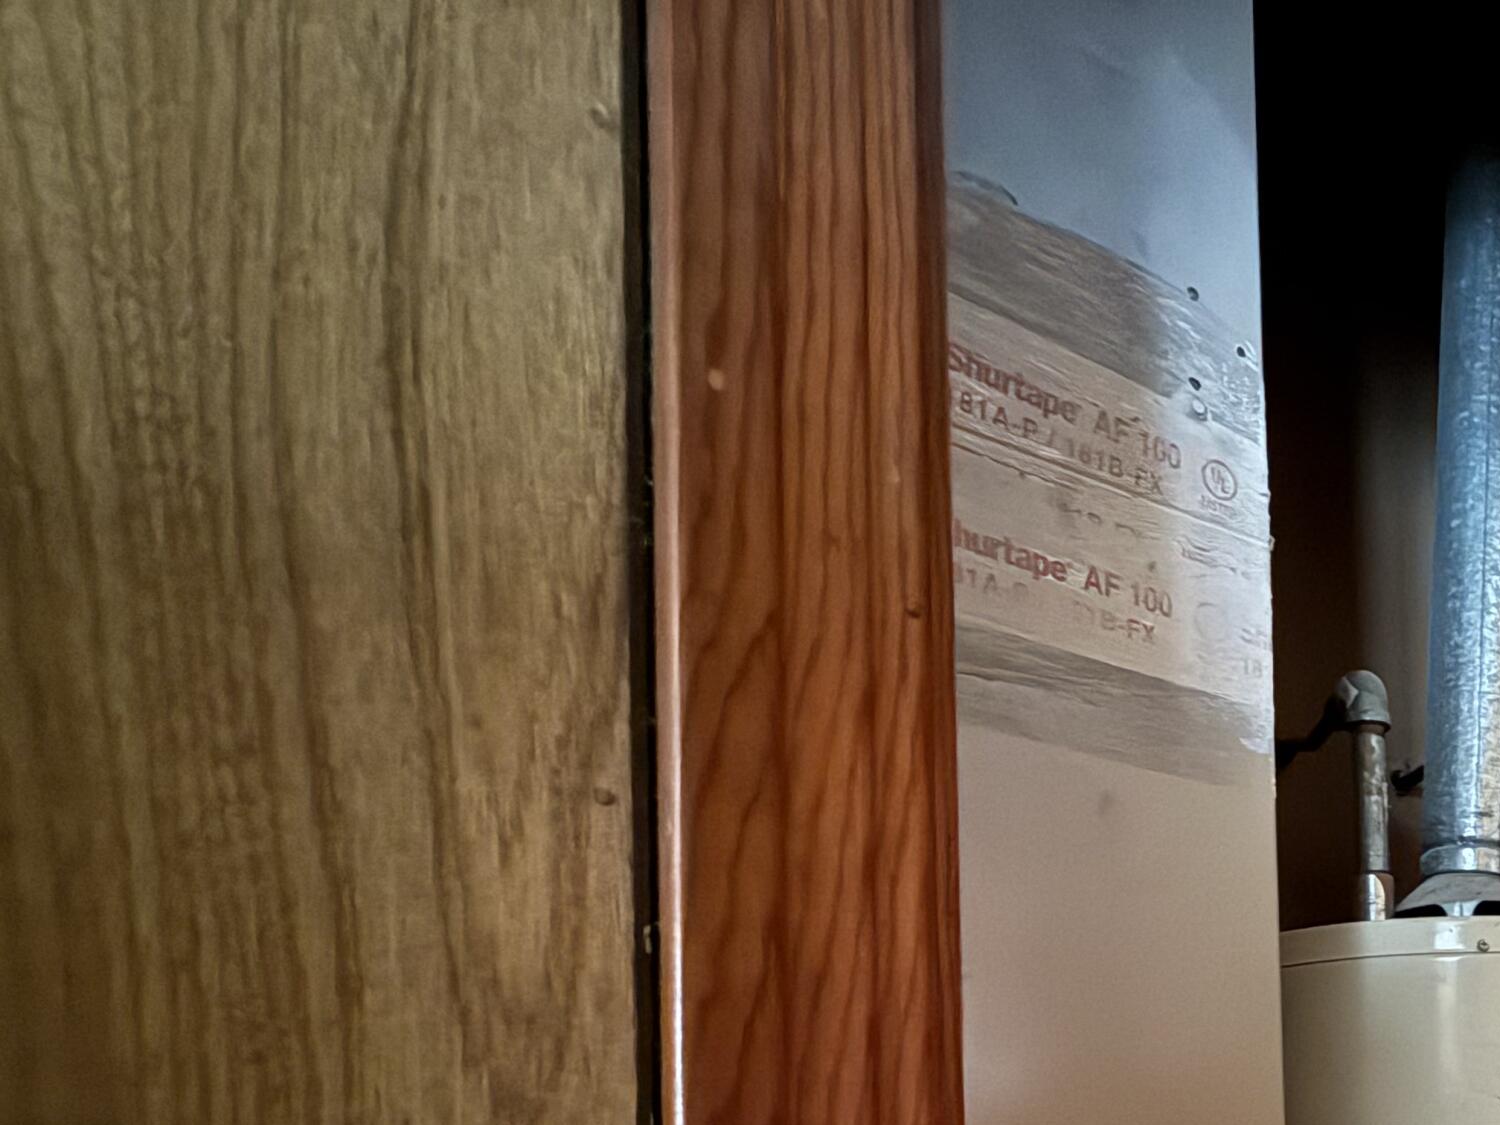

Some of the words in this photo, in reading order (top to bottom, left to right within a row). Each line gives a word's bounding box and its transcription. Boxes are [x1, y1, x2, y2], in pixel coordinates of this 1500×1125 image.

[952, 518, 1067, 582] hurtape
[1084, 565, 1121, 597] AF
[1131, 583, 1173, 618] 100
